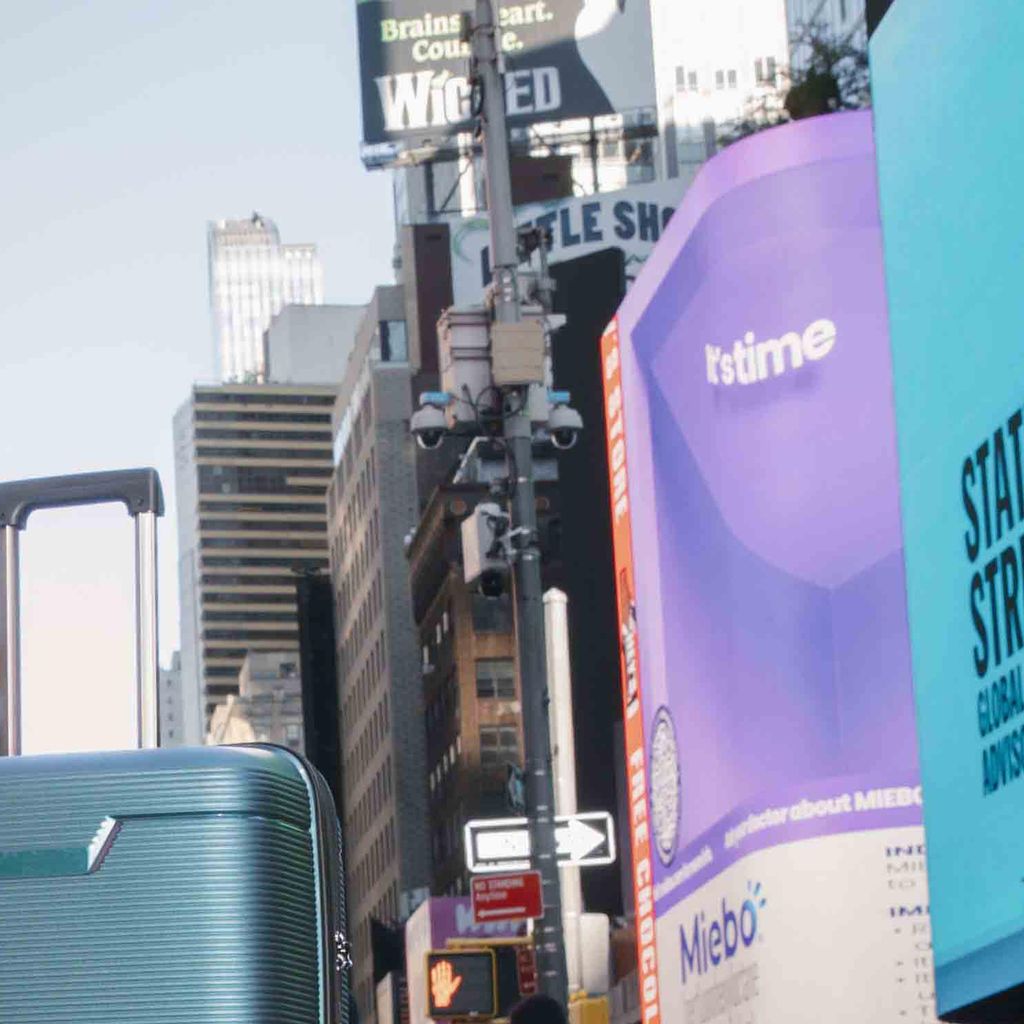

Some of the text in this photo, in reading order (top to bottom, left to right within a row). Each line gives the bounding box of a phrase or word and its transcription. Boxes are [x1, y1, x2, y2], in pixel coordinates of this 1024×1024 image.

[498, 1, 554, 27] eart.
[733, 318, 837, 386] time
[970, 534, 1024, 679] STR
[789, 795, 852, 822] about
[679, 896, 758, 985] Miebo
